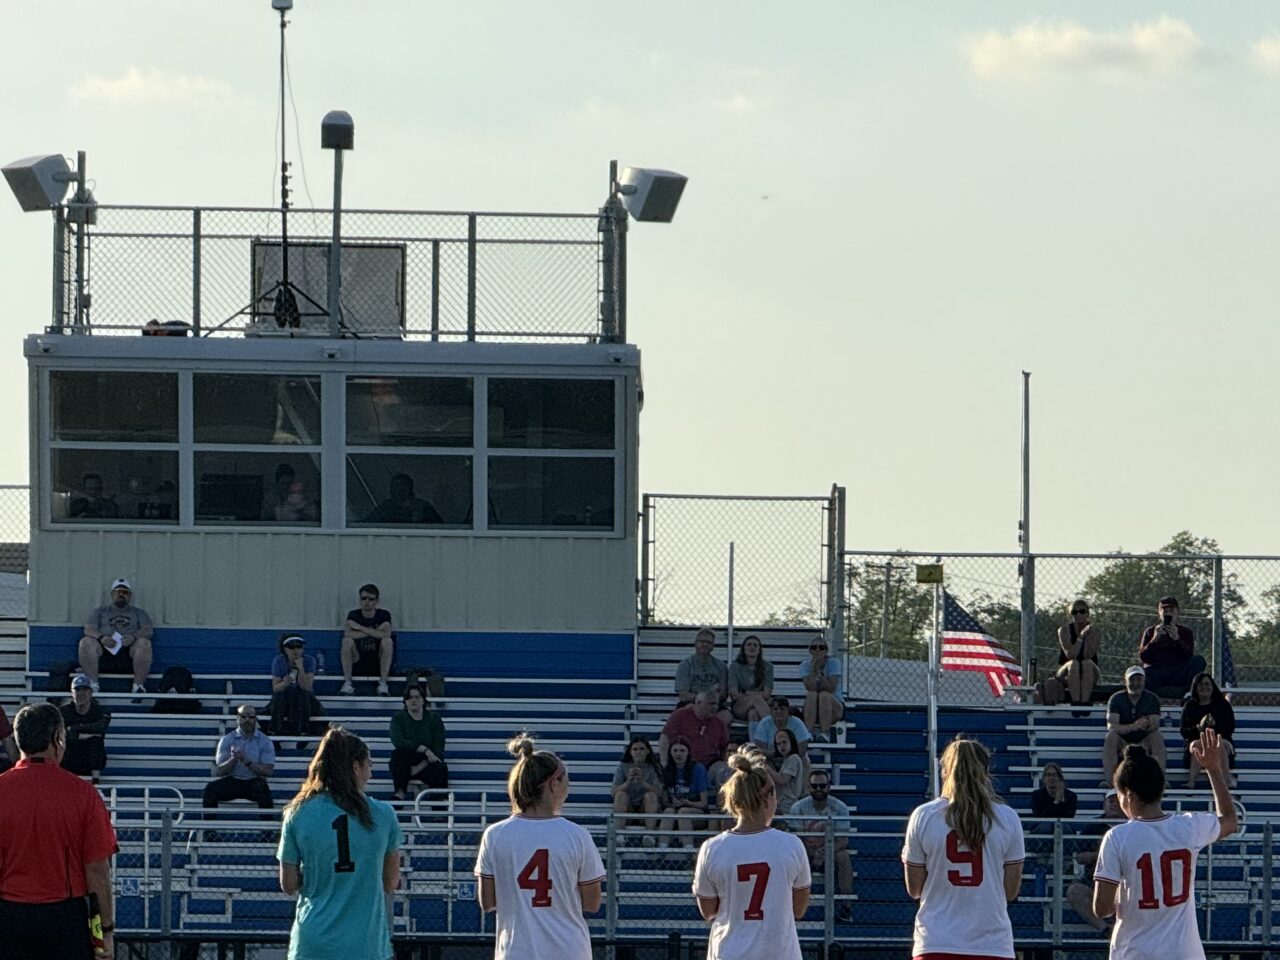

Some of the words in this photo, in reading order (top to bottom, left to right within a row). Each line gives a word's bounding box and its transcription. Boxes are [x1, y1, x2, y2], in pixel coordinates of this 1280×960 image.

[332, 813, 356, 874] 1
[945, 829, 984, 887] 9
[516, 848, 553, 908] 4
[736, 861, 771, 921] 7
[1136, 848, 1192, 910] 10
